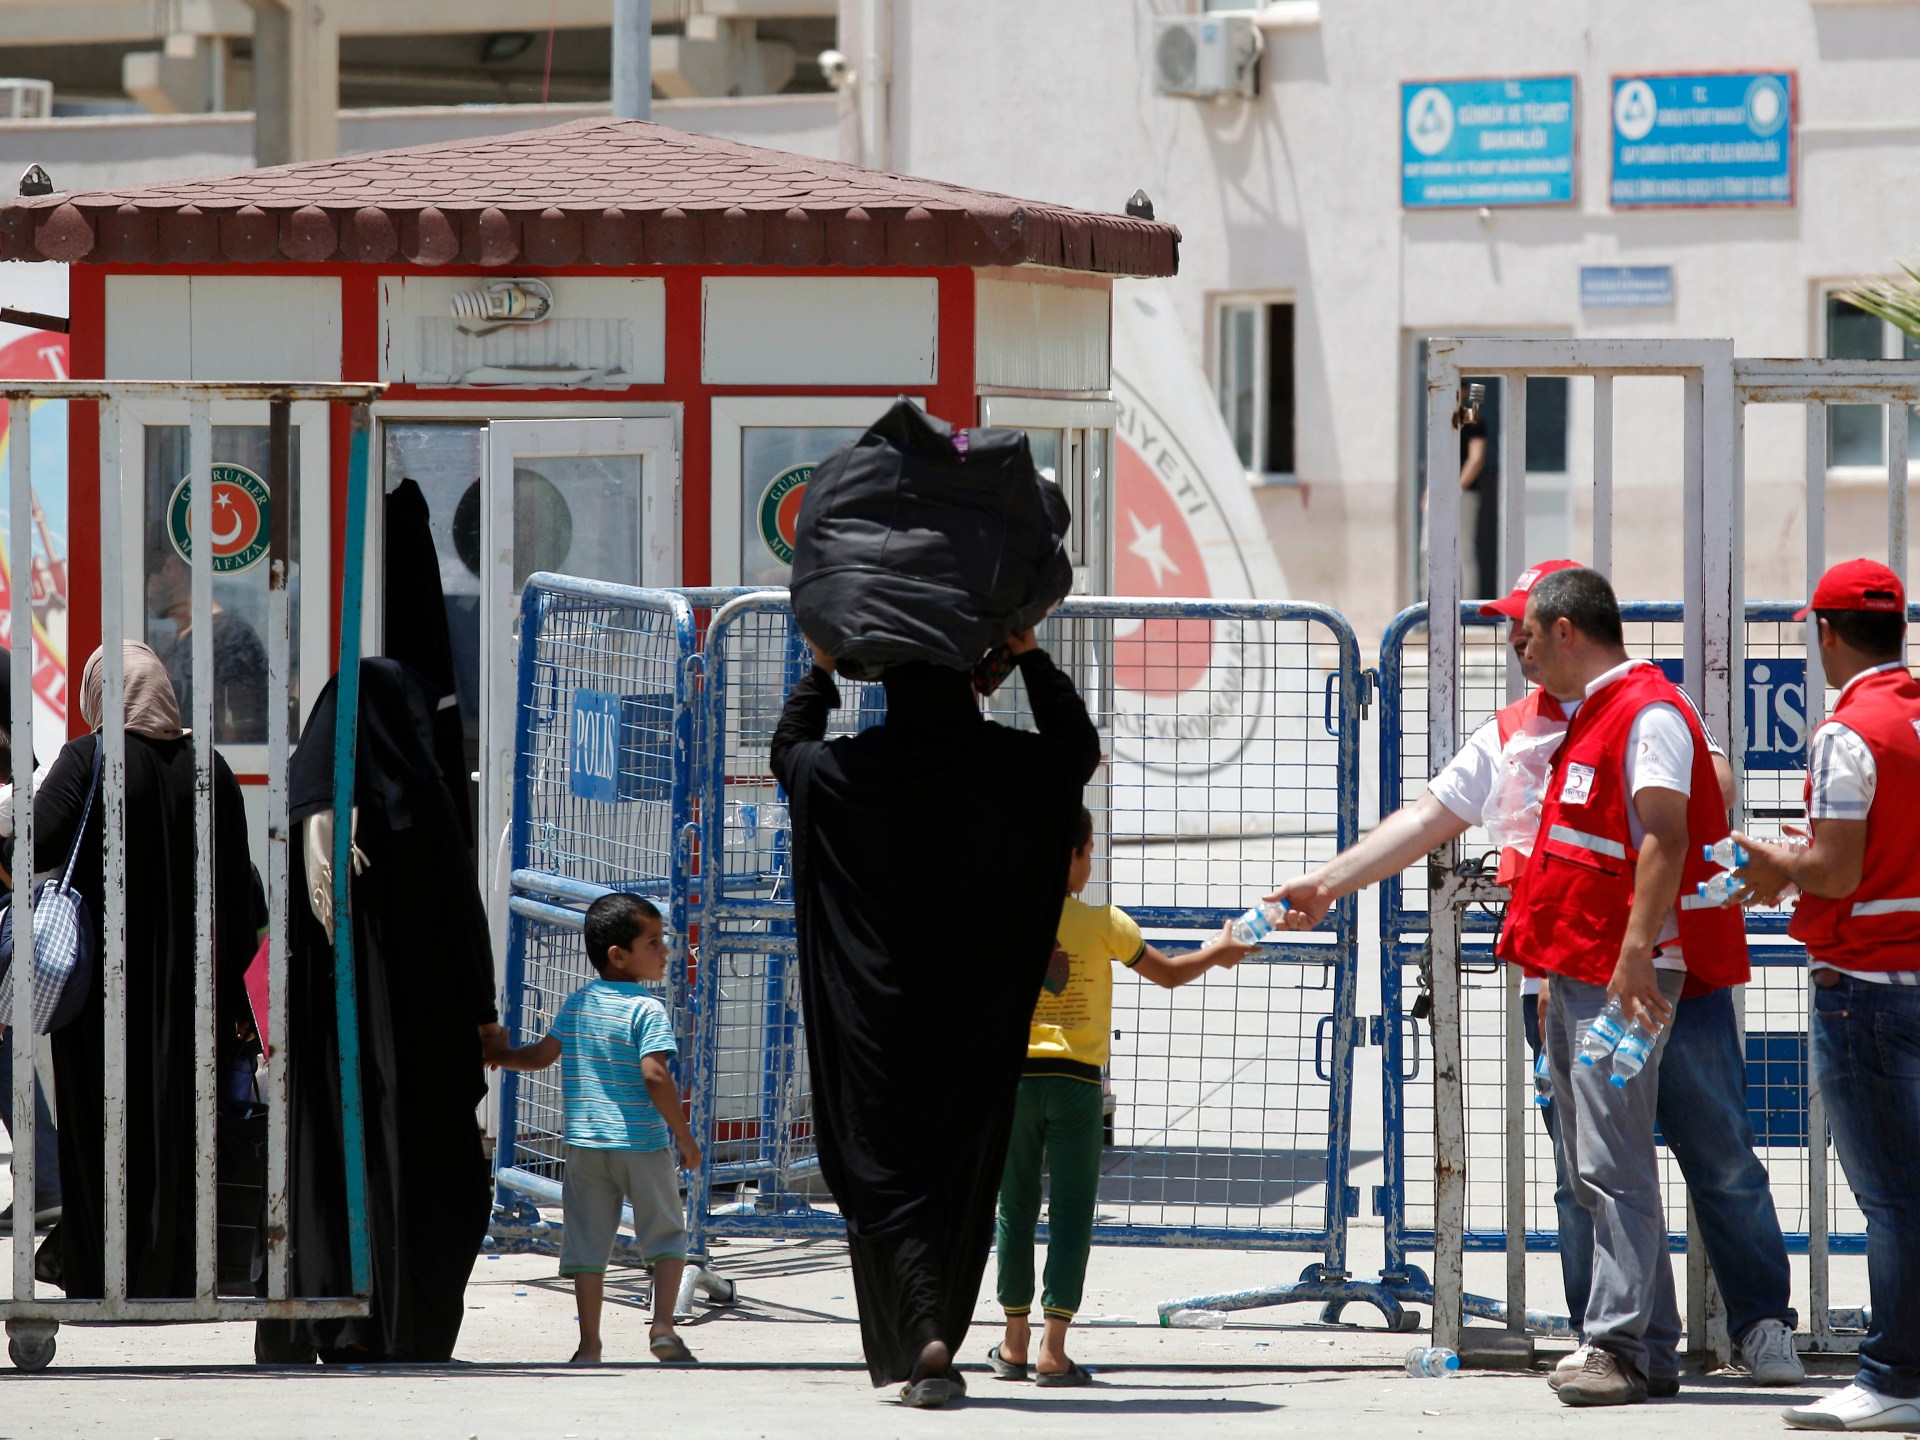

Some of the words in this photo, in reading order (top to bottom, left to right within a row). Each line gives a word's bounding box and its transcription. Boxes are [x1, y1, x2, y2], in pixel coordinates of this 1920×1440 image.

[180, 467, 267, 506] GRÜKLER
[770, 469, 812, 501] GÜMR
[179, 538, 263, 570] MAFAZA
[1745, 664, 1807, 753] İS
[574, 699, 615, 781] POLİS
